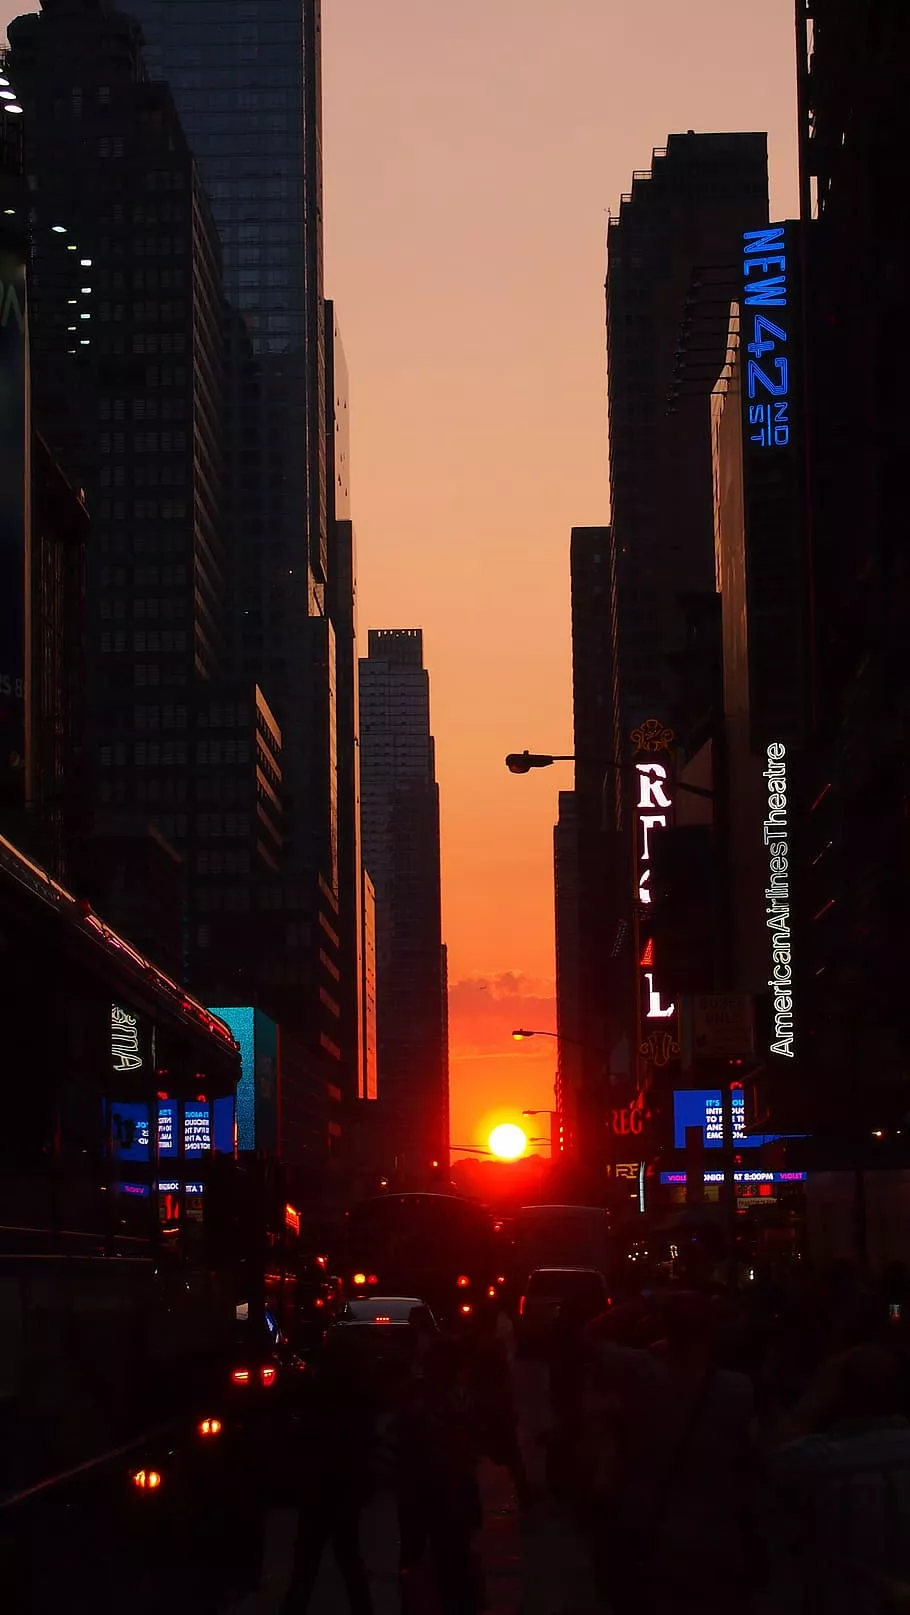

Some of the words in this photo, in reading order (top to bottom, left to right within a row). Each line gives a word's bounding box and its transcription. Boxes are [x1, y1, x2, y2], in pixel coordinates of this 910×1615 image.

[743, 227, 787, 306] NEW
[705, 1099, 721, 1107] IT'S
[705, 1115, 718, 1123] TO
[744, 1172, 774, 1181] 8:00PM
[779, 1172, 803, 1180] VIOLET
